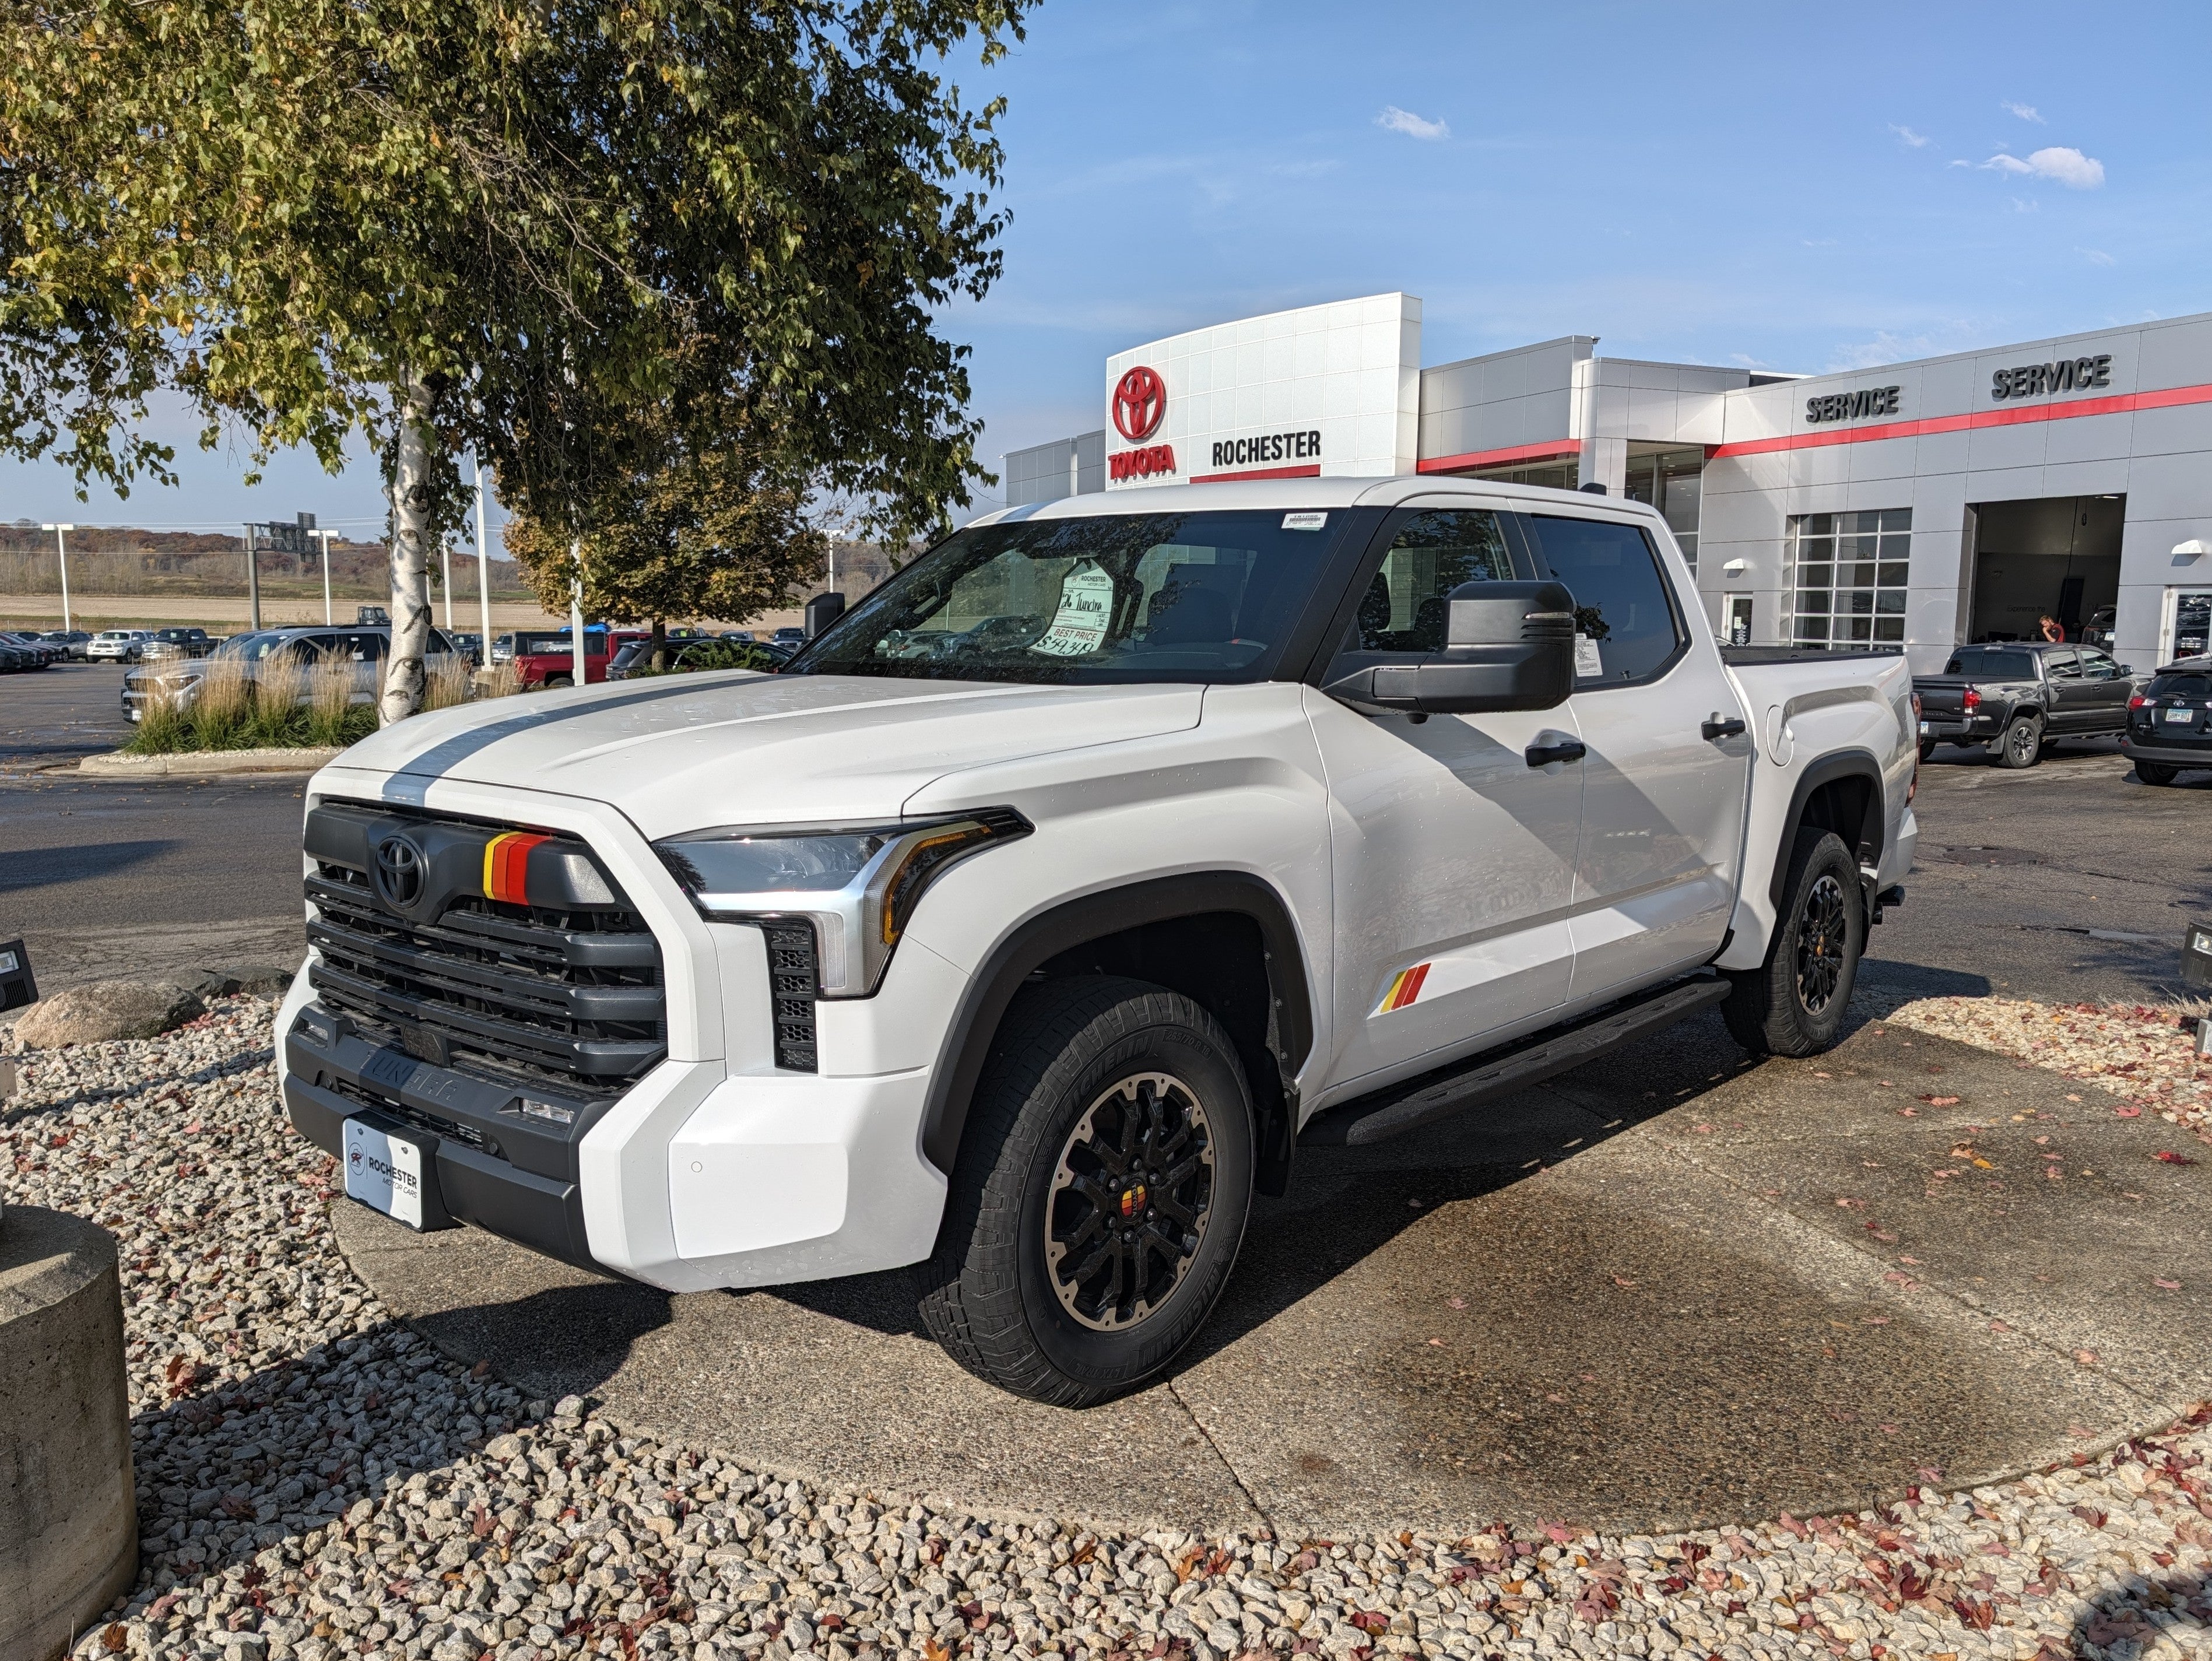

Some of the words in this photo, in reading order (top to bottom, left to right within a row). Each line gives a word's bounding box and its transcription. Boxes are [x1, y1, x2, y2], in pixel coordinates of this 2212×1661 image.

[1992, 354, 2112, 398] SERVICE
[1806, 385, 1900, 423] SERVICE
[1108, 444, 1176, 480] TOYOTA
[1212, 430, 1321, 466] ROCHESTER
[1076, 592, 1102, 611] Tundra
[1037, 635, 1094, 655] $59,349
[1054, 628, 1074, 638] BEST
[1074, 631, 1098, 641] PRICE
[360, 1049, 459, 1101] TUNDRA
[1056, 1035, 1150, 1131] MICHELIN
[368, 1156, 417, 1189] ROCHESTER
[382, 1177, 403, 1192] MOTOR
[403, 1185, 418, 1199] CARS
[1141, 1267, 1223, 1367] MICHELIN
